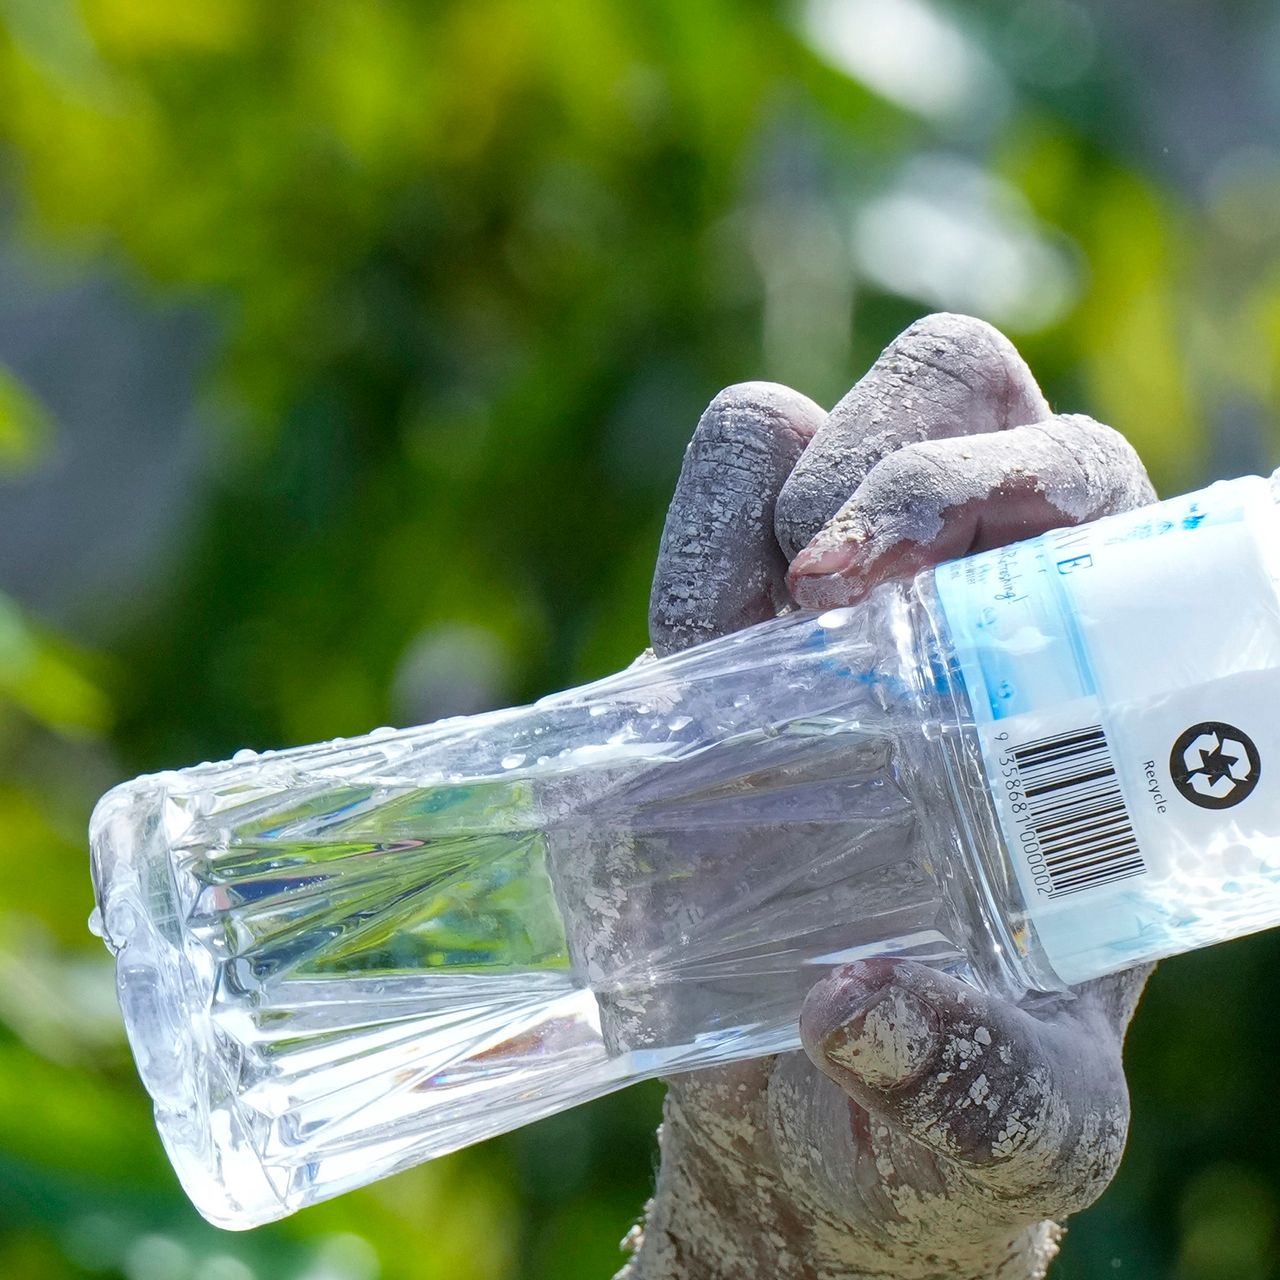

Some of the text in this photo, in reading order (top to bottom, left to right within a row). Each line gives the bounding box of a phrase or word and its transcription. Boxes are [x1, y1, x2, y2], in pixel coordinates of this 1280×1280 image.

[994, 732, 1054, 896] 9 358681 000002
[1143, 760, 1168, 814] Recycle
